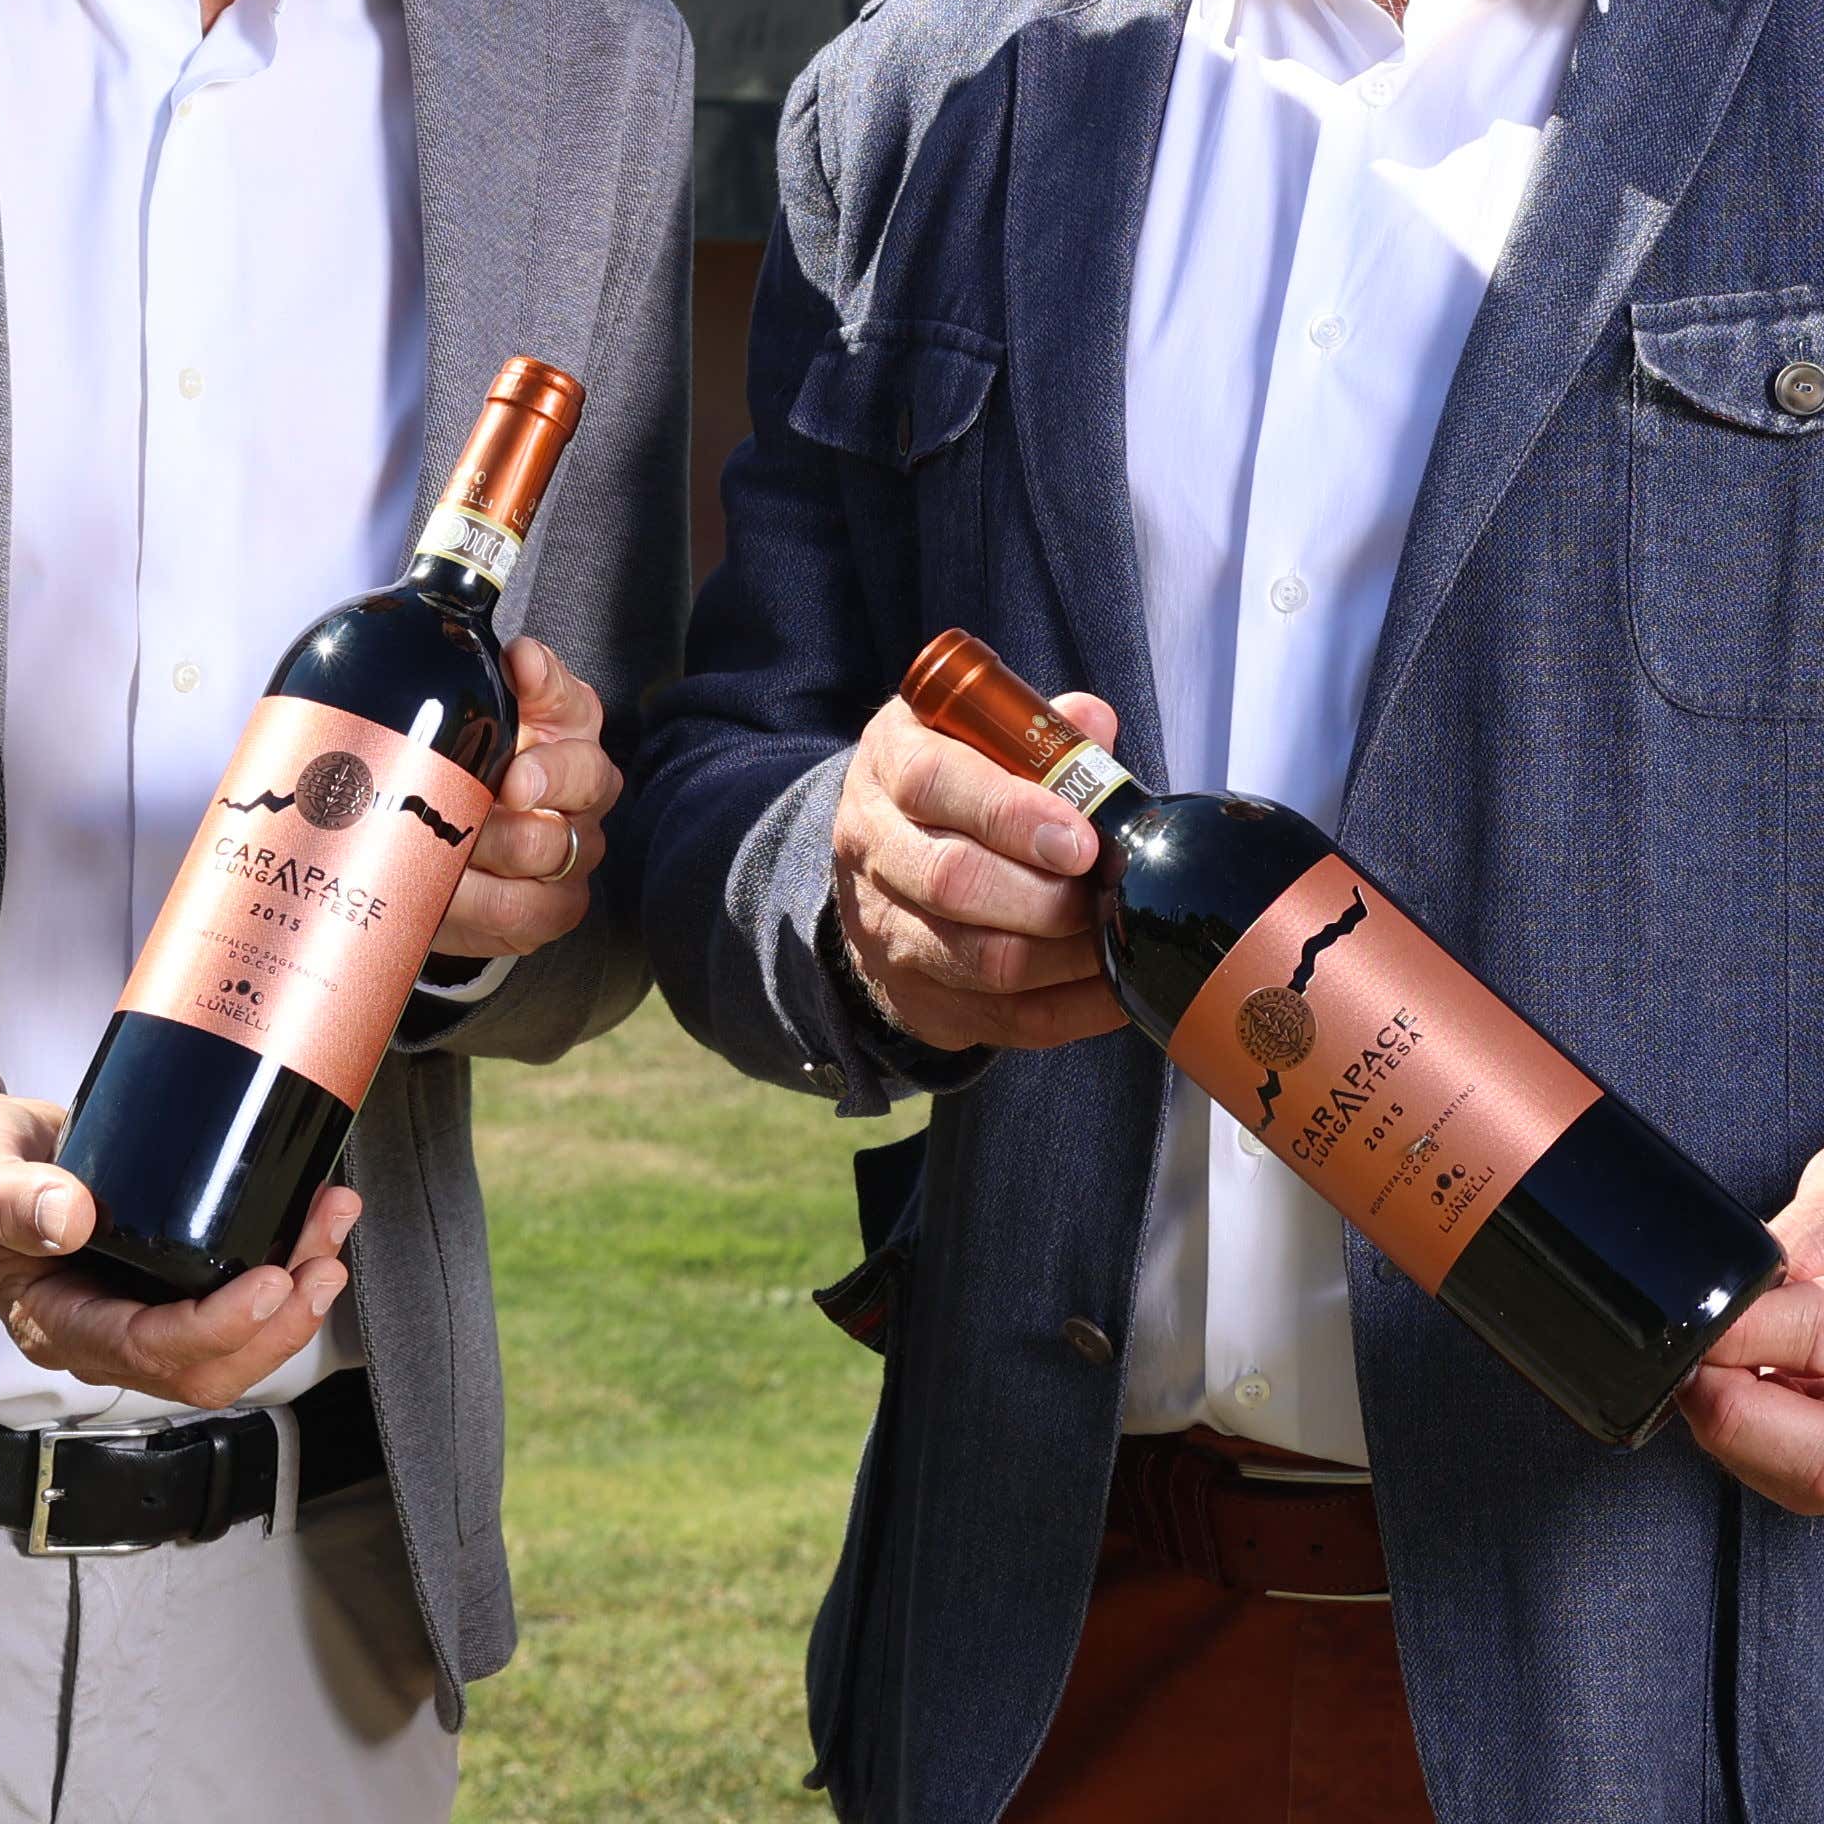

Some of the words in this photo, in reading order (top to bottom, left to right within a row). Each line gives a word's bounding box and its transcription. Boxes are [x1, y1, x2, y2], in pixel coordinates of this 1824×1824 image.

[1029, 727, 1081, 768] LUNEL
[214, 858, 369, 931] LUNGATTESA
[215, 836, 388, 920] CARAPACE
[249, 902, 302, 932] 2015
[262, 950, 339, 993] SAGRANNO
[195, 994, 271, 1033] LUNELLI
[1291, 1007, 1418, 1161] CARAPACE
[1310, 1030, 1424, 1169] LUNGATTESA
[1363, 1102, 1405, 1152] 2015
[1369, 1154, 1415, 1216] MONTEFALCO
[1421, 1084, 1476, 1146] GRANTINO
[1439, 1165, 1496, 1234] LUNELLI
